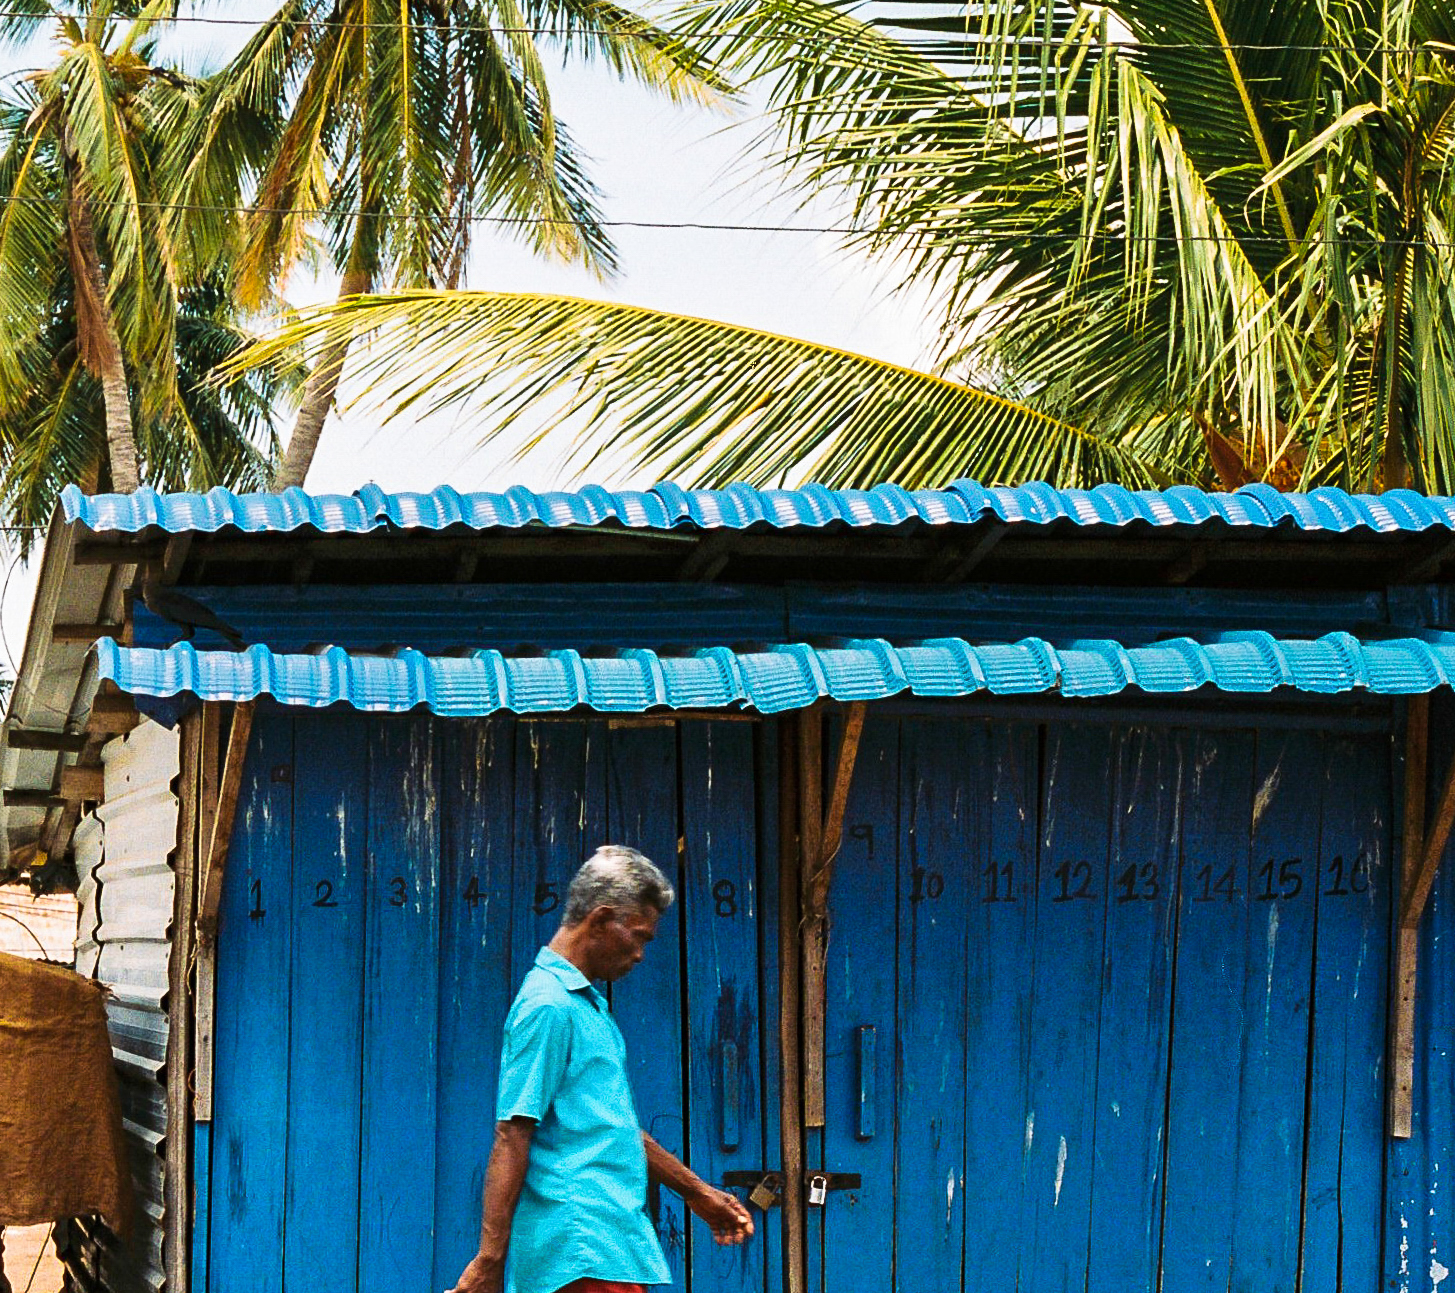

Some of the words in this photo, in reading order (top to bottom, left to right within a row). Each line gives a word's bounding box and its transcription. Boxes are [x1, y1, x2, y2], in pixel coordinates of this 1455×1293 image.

[848, 823, 874, 860] 9
[908, 866, 945, 903] 10
[981, 860, 1017, 903] 11
[1052, 859, 1097, 903] 12
[1117, 861, 1160, 904] 13
[1193, 860, 1241, 903] 14
[1254, 856, 1303, 902] 15
[246, 878, 266, 919] 1
[312, 879, 339, 907] 2
[389, 876, 408, 907] 3
[463, 875, 488, 910] 4
[532, 881, 561, 916] 5
[713, 878, 738, 918] 8
